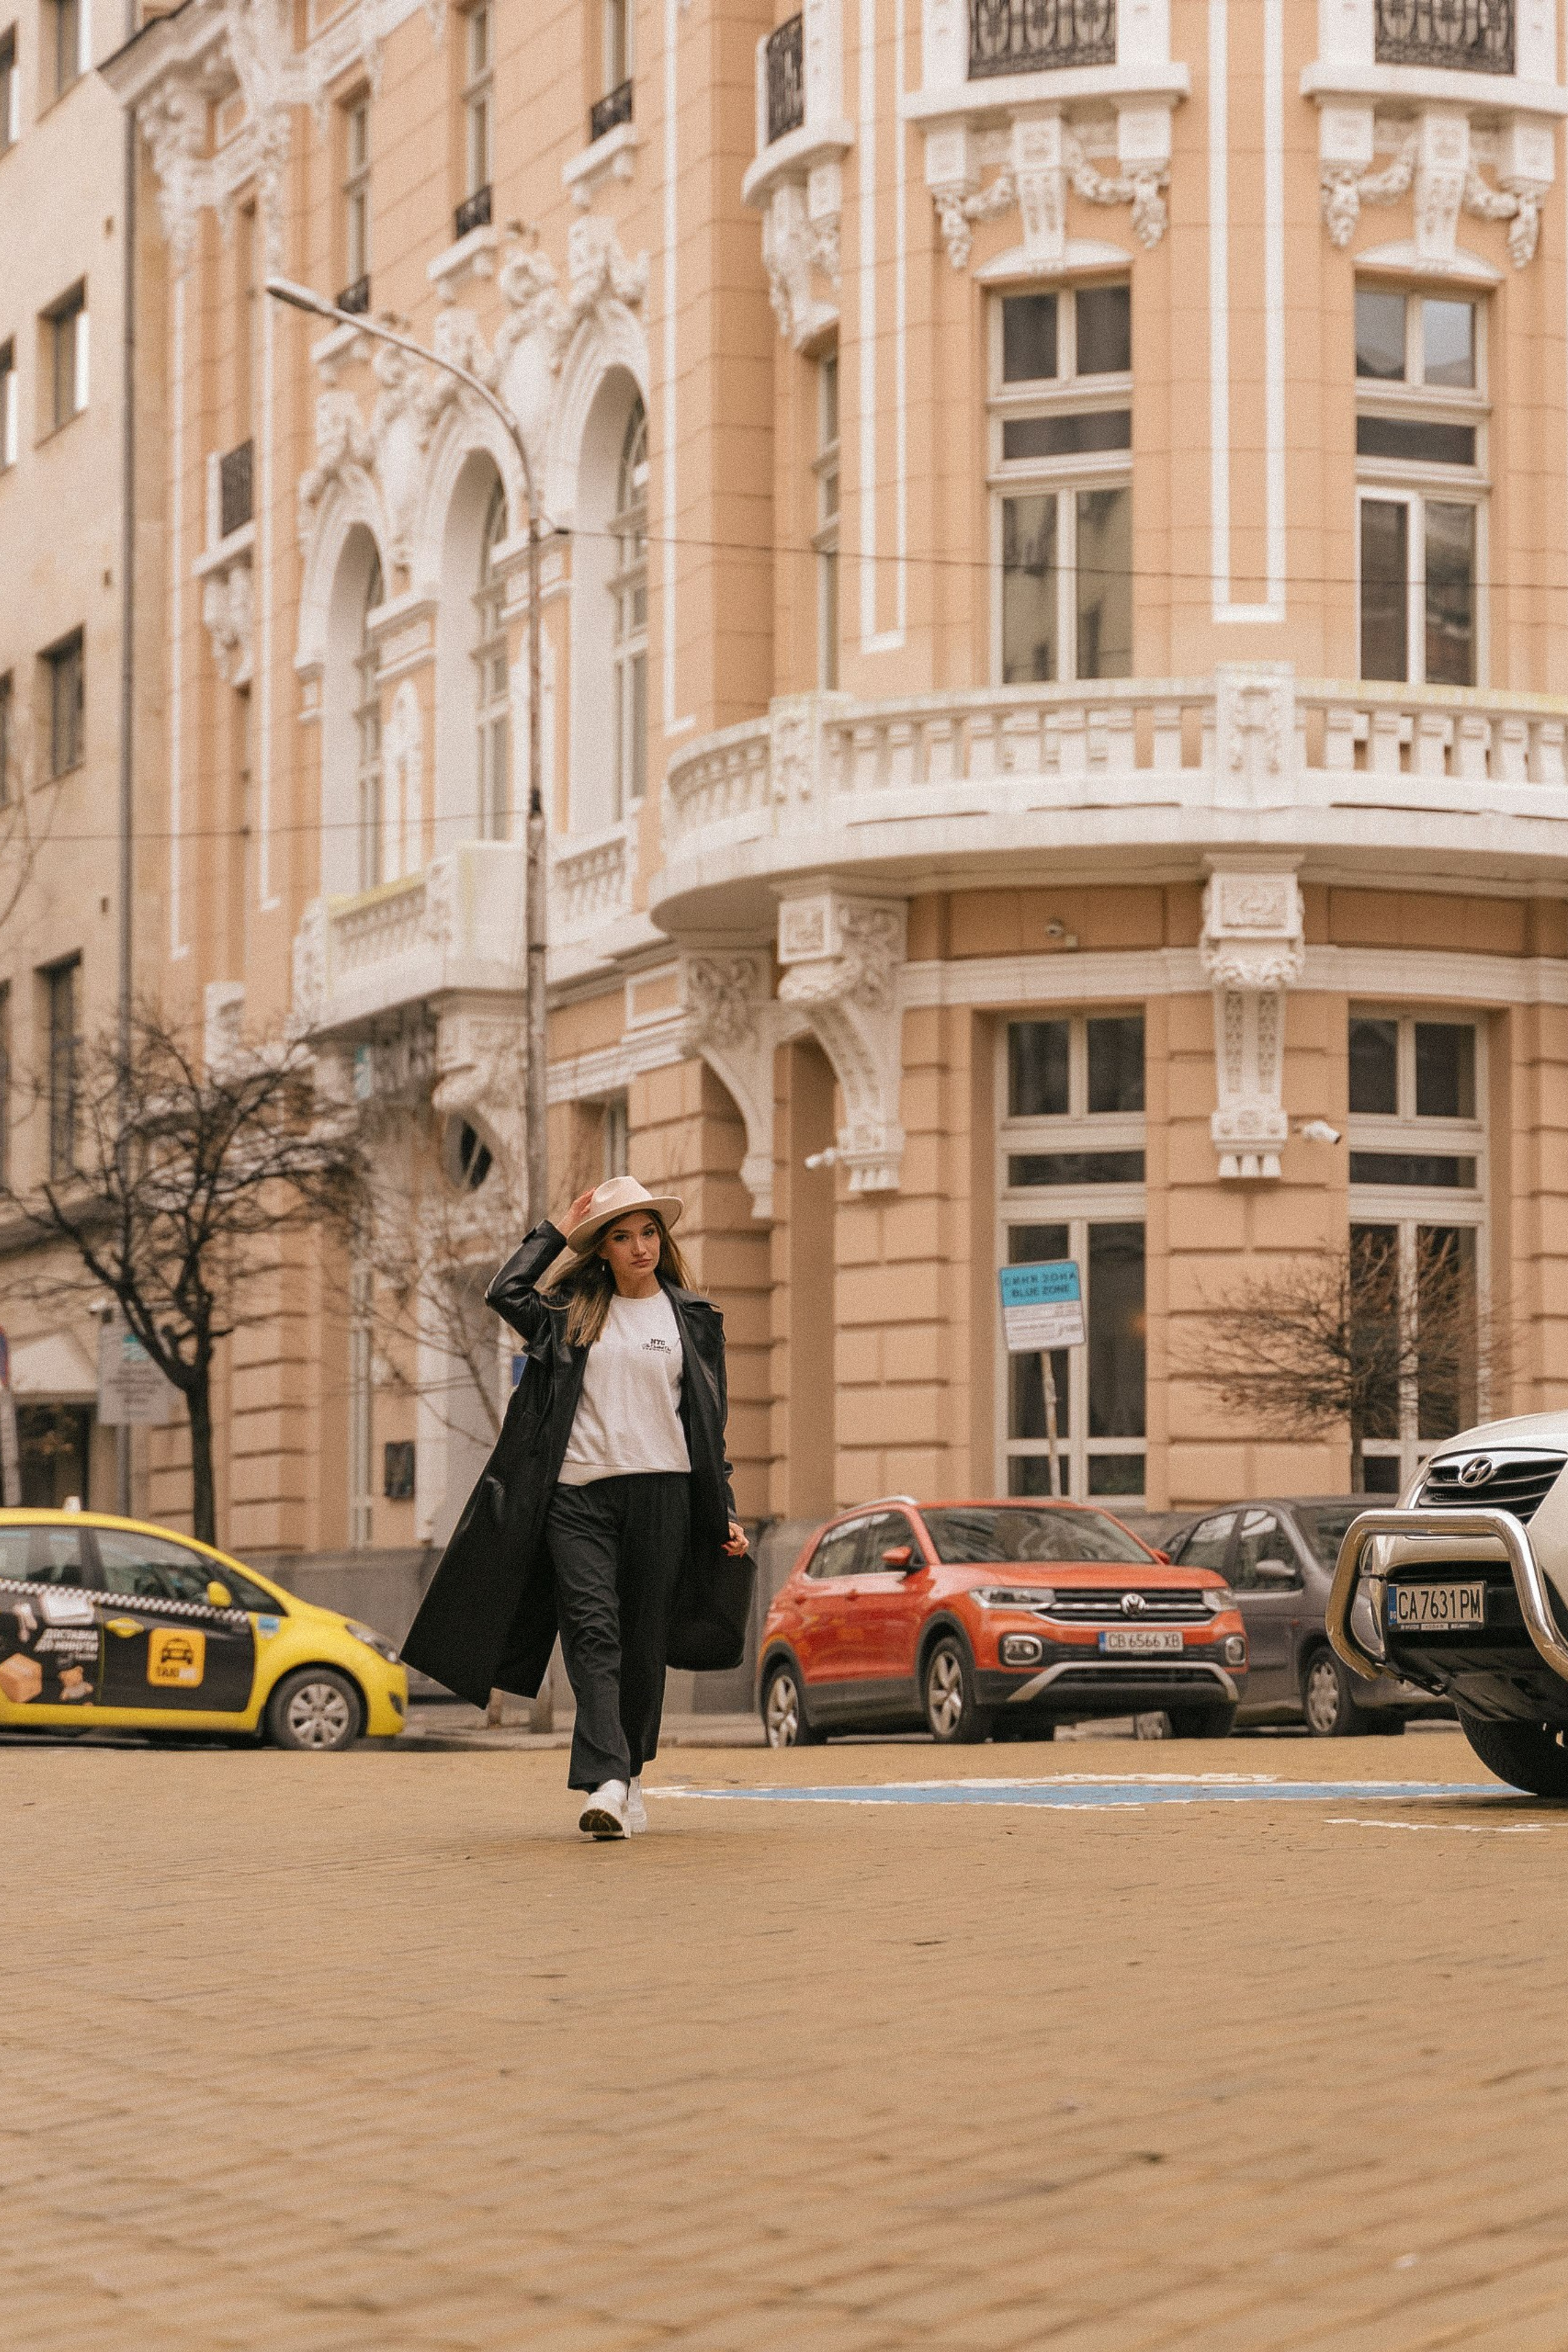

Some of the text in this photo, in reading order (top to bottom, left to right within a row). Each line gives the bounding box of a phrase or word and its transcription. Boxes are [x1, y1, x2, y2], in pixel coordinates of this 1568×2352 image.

[1005, 1272, 1076, 1286] СИНЯ ЗОНА
[1012, 1284, 1069, 1297] BLUE ZONE
